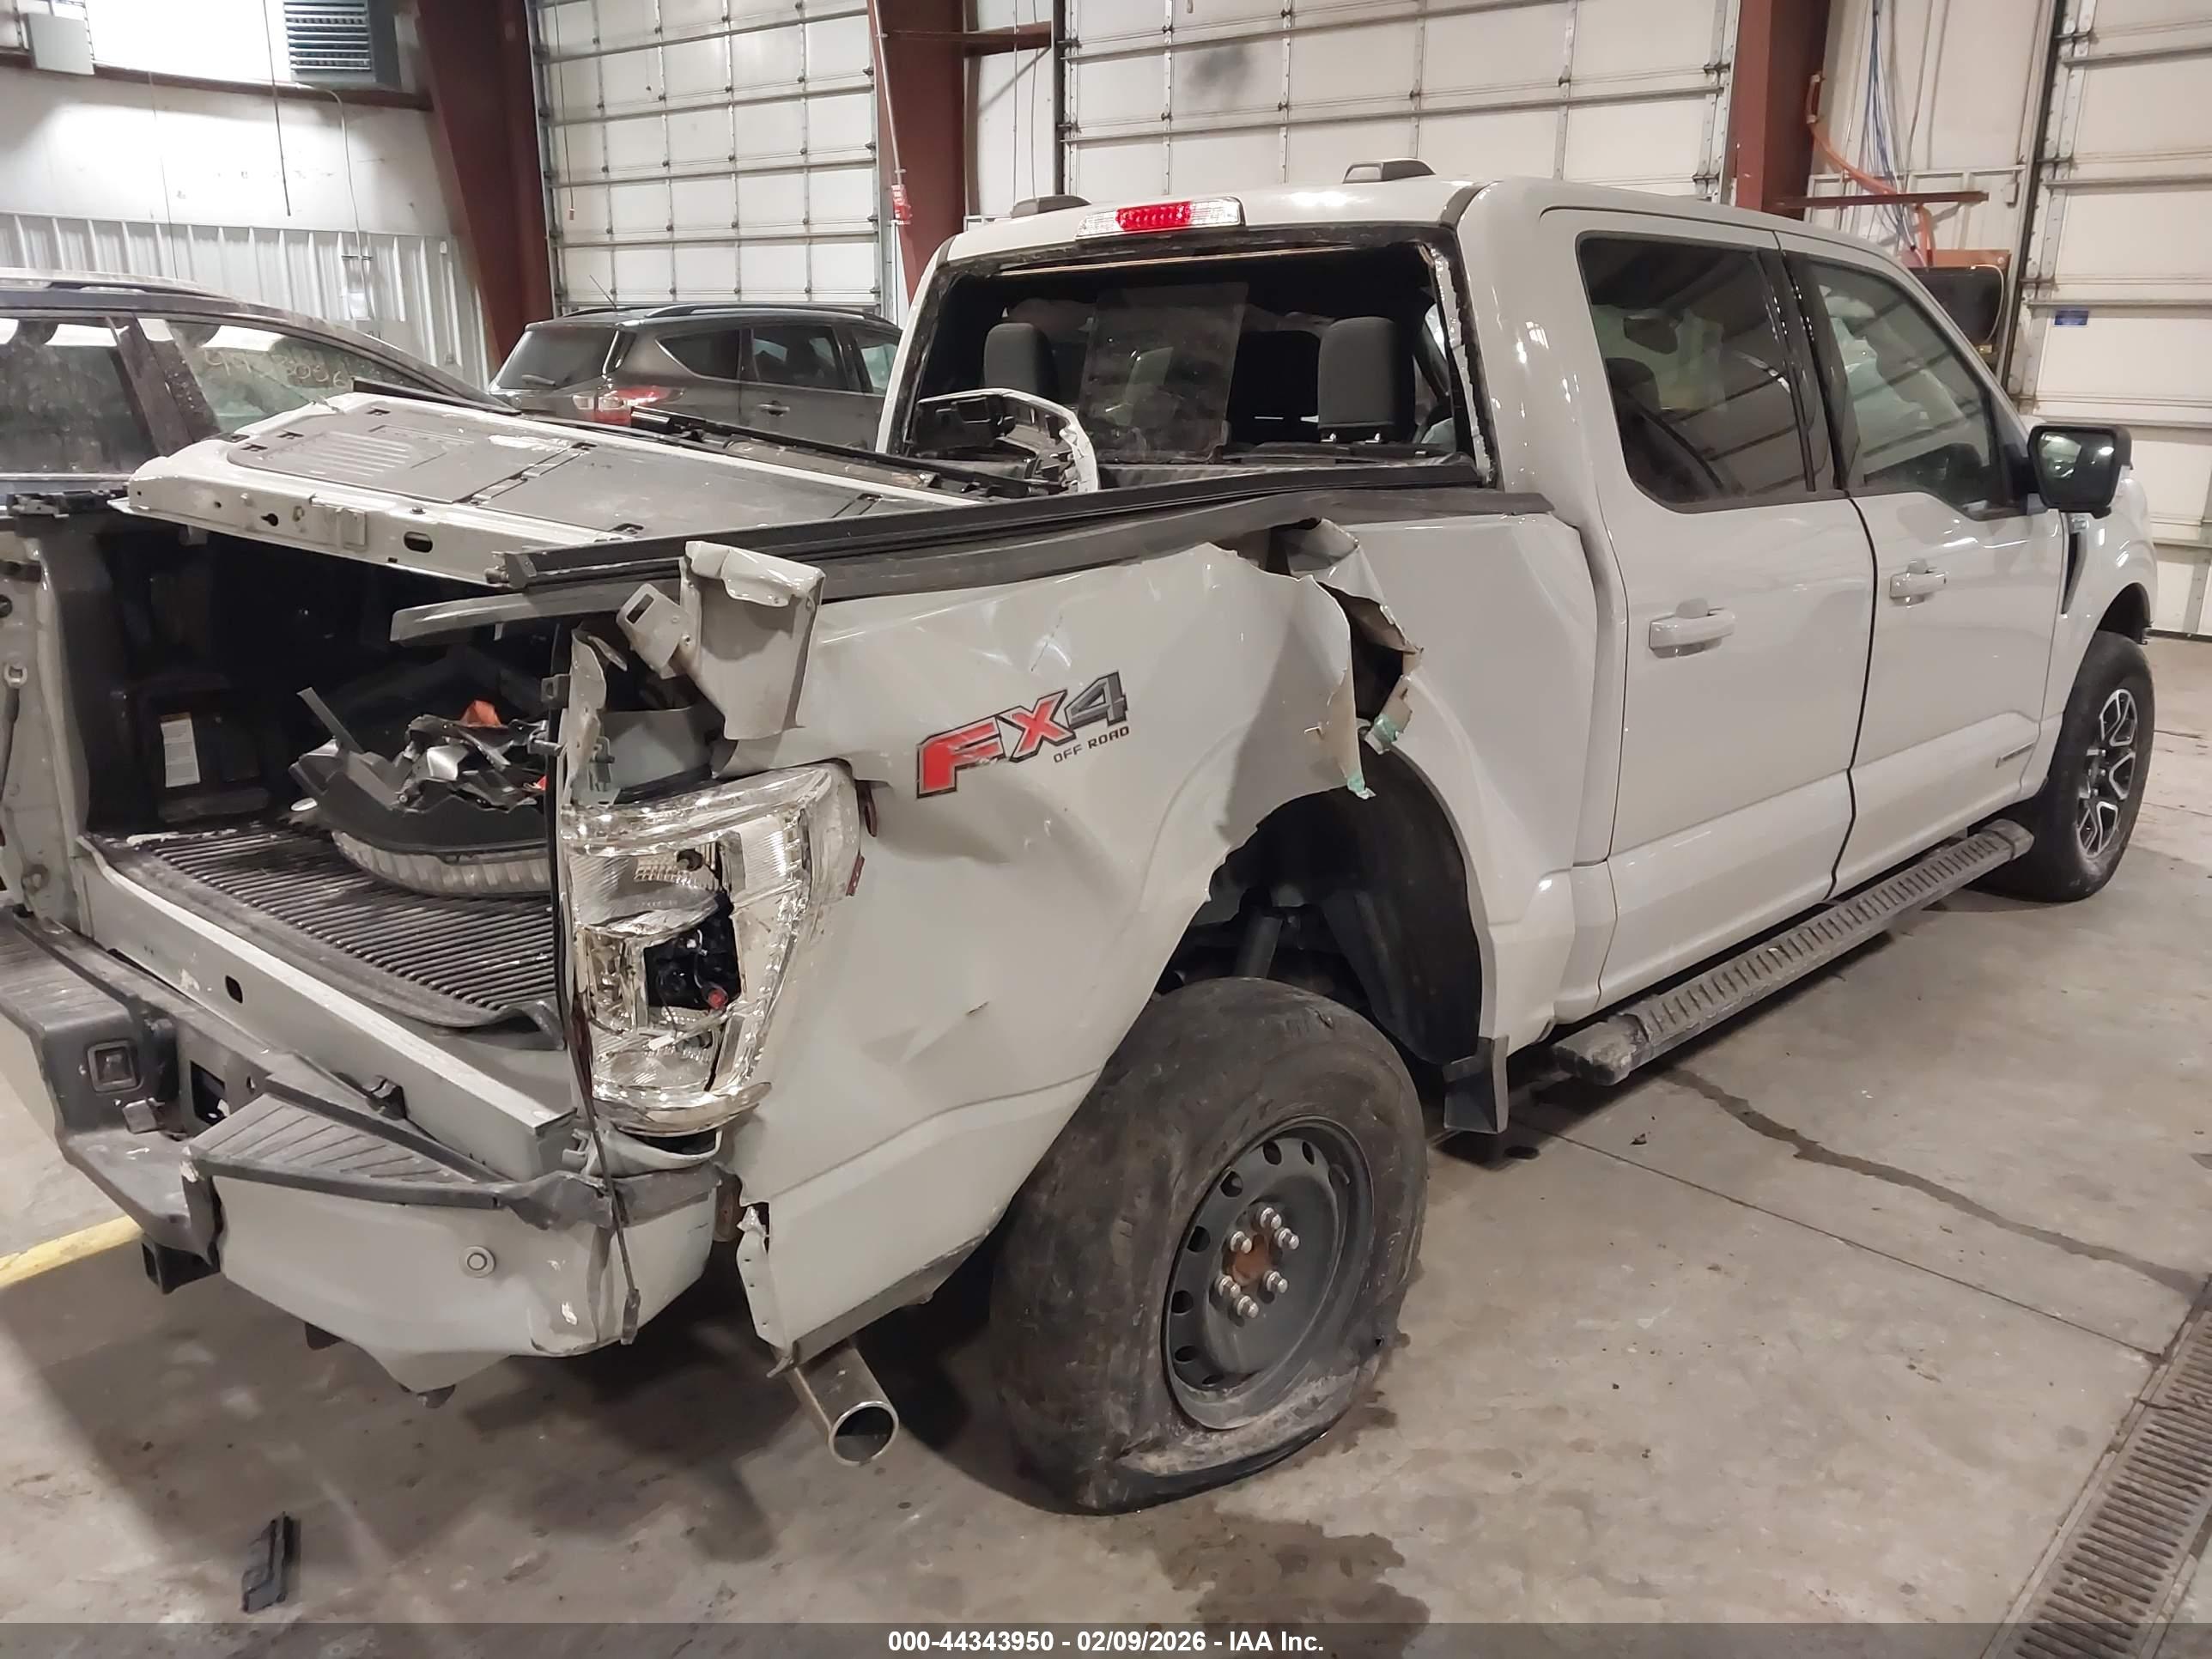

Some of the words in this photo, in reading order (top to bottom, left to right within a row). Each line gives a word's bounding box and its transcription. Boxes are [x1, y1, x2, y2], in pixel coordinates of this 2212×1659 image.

[916, 671, 1129, 799] FX4
[1053, 744, 1083, 763] OFF
[1088, 726, 1130, 750] ROAD
